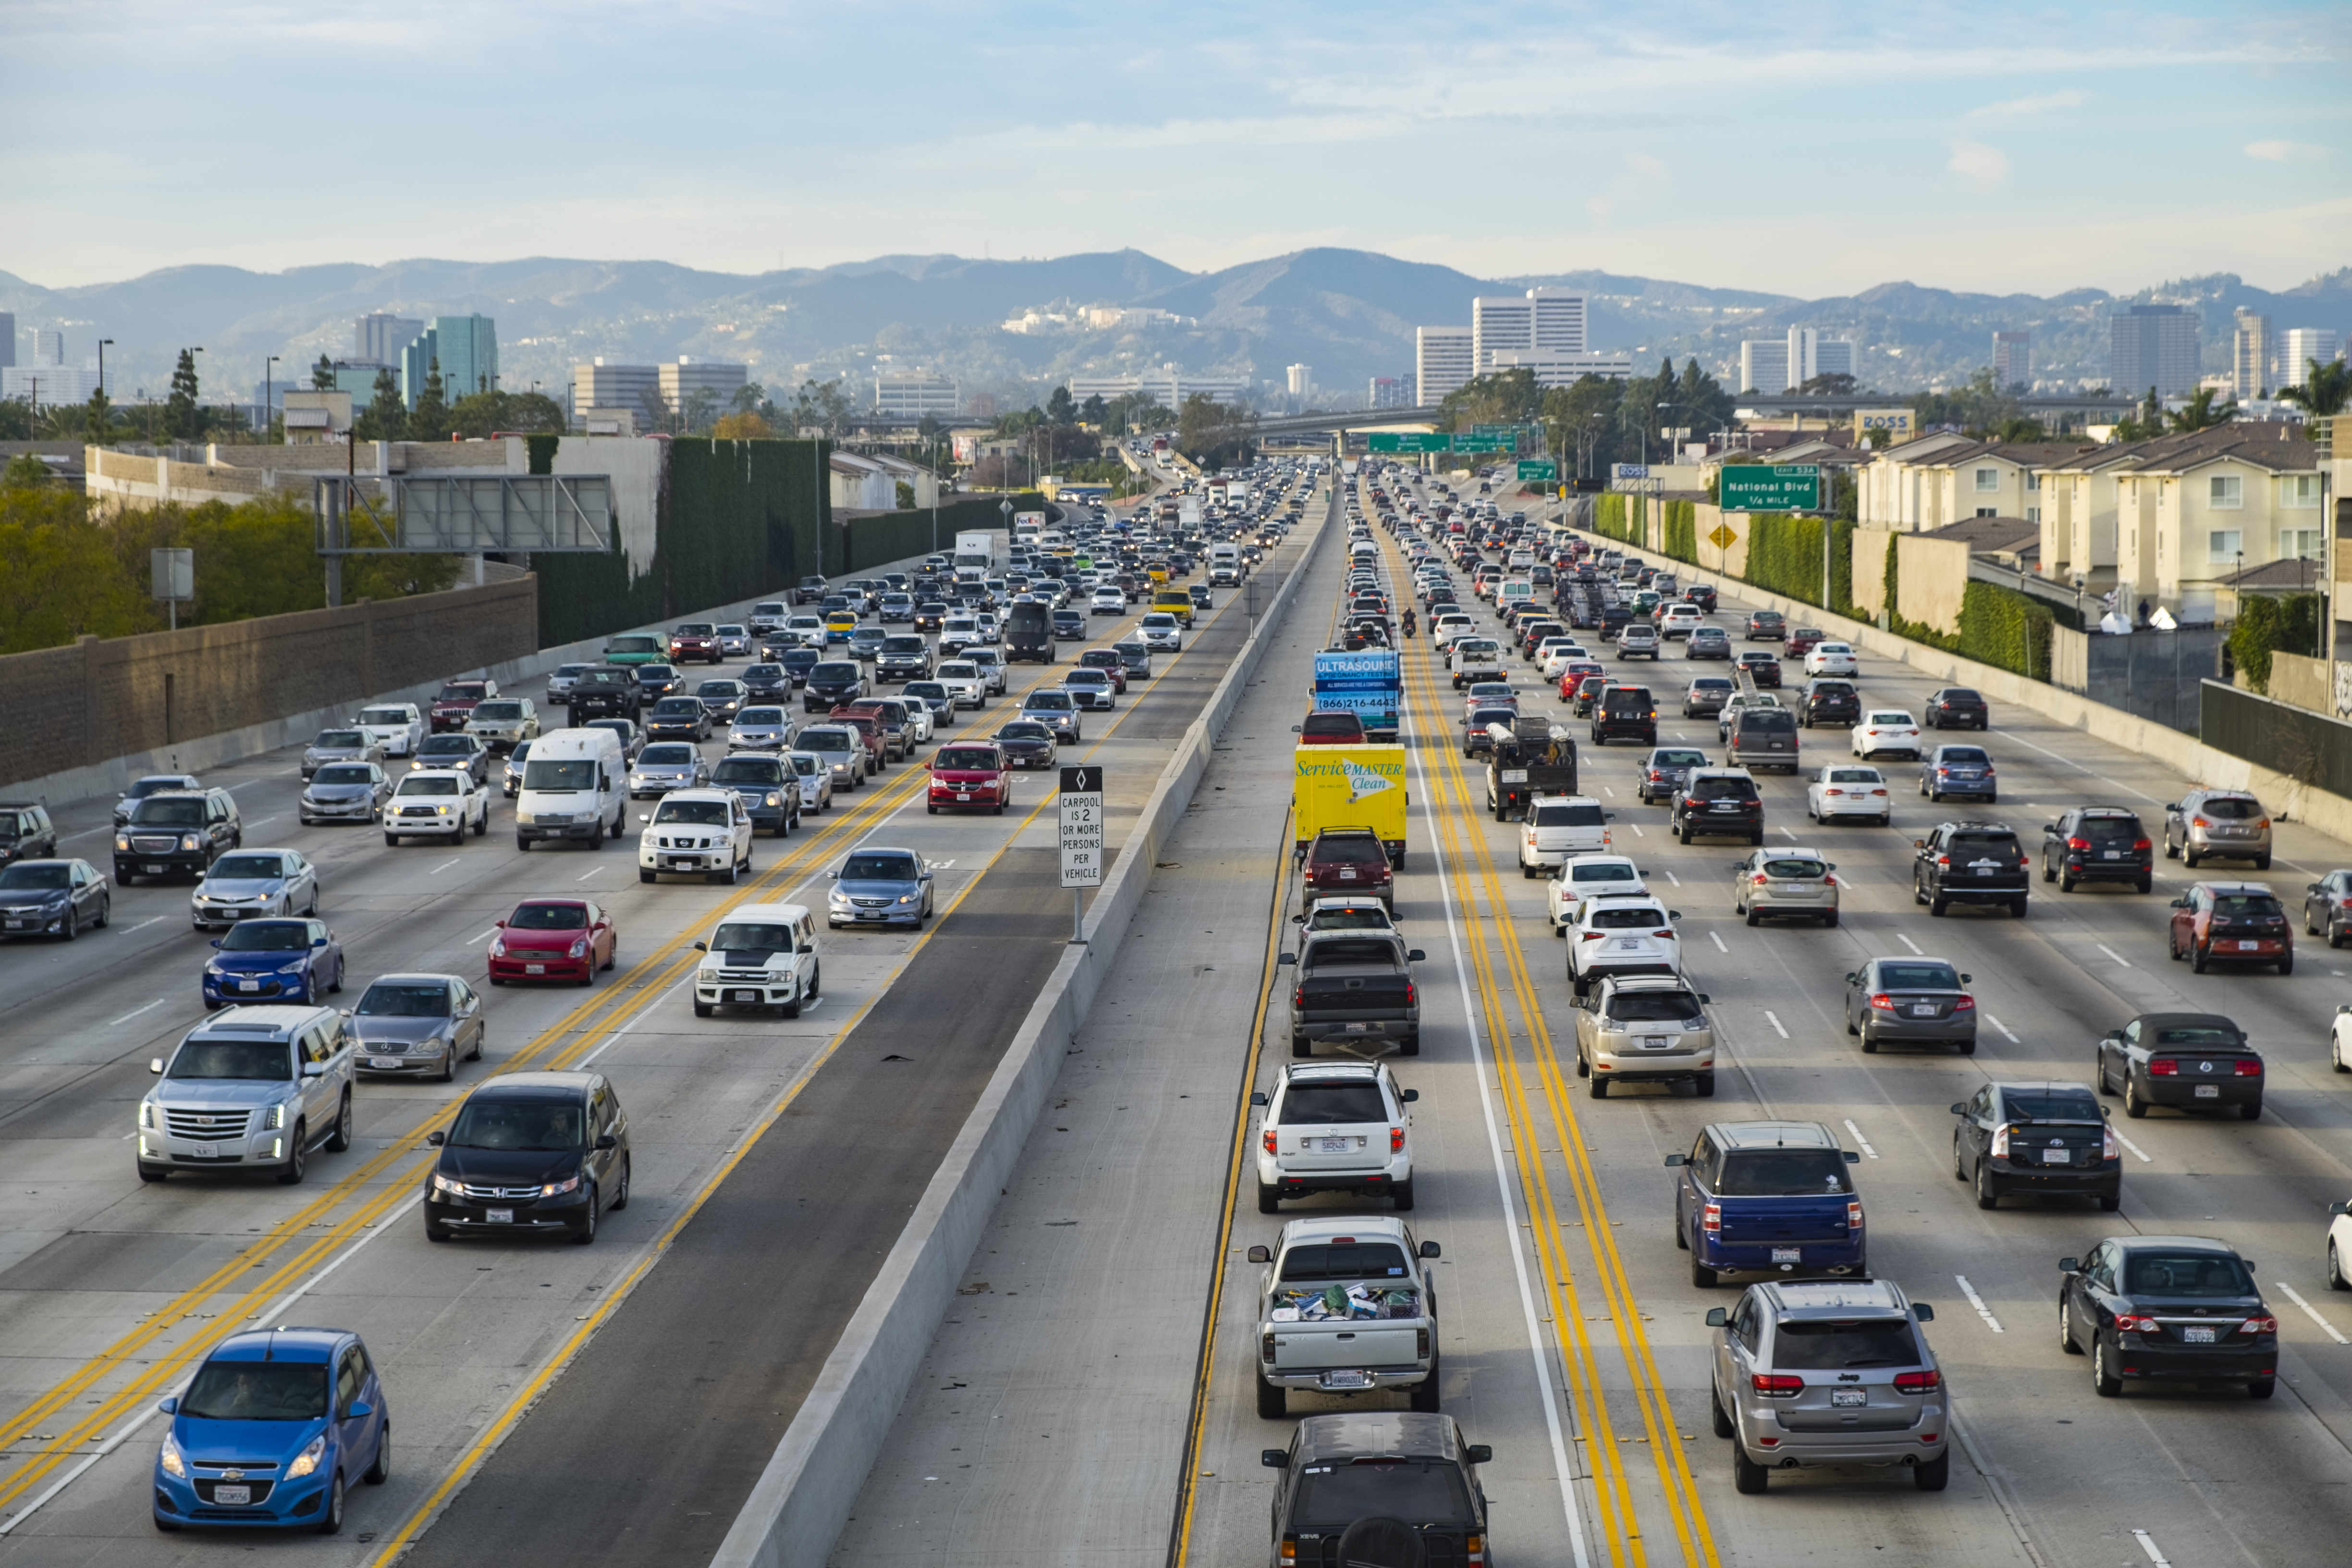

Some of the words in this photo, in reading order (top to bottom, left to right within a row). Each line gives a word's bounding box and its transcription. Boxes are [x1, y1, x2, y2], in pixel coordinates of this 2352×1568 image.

[1864, 416, 1907, 428] ROSS
[1620, 467, 1647, 476] ROSS
[1729, 482, 1779, 491] National
[1784, 482, 1810, 491] Blvd
[1766, 496, 1789, 504] MILE
[1317, 660, 1395, 672] ULTRASOUND
[1352, 777, 1386, 789] Clean
[1063, 797, 1100, 808] CARPOOL
[1071, 811, 1079, 821] IS
[1082, 809, 1090, 821] 2
[1063, 826, 1074, 835] OR
[1077, 824, 1100, 834] MORE
[1063, 839, 1100, 849] PERSONS
[1074, 854, 1089, 864] PER
[1065, 868, 1097, 879] VEHICLE
[1838, 1373, 1860, 1383] Jeep
